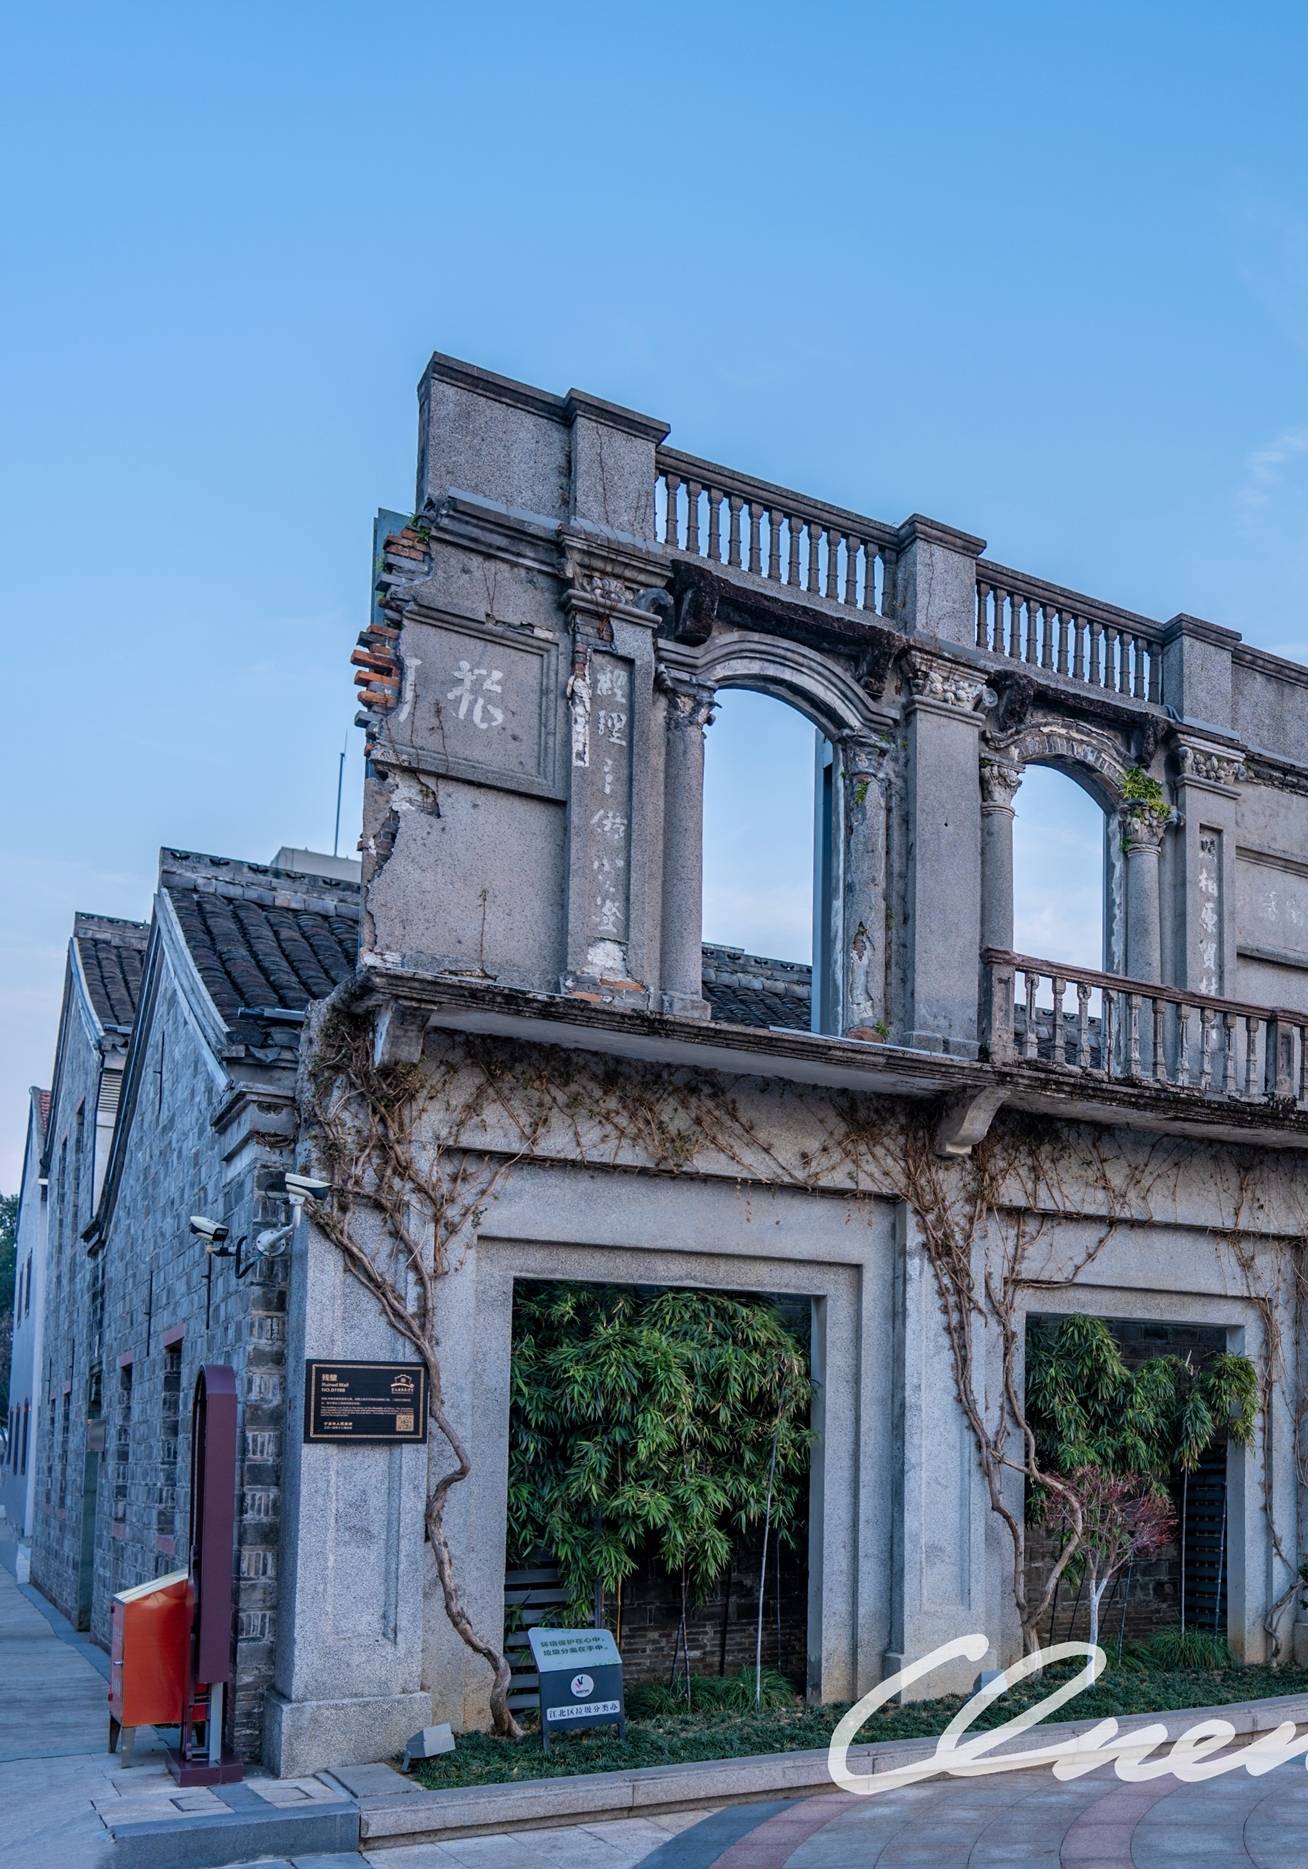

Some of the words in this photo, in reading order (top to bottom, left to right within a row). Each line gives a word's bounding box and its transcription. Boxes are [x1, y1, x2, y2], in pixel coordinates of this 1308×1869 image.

[549, 1703, 618, 1719] 江北区垃圾分类办
